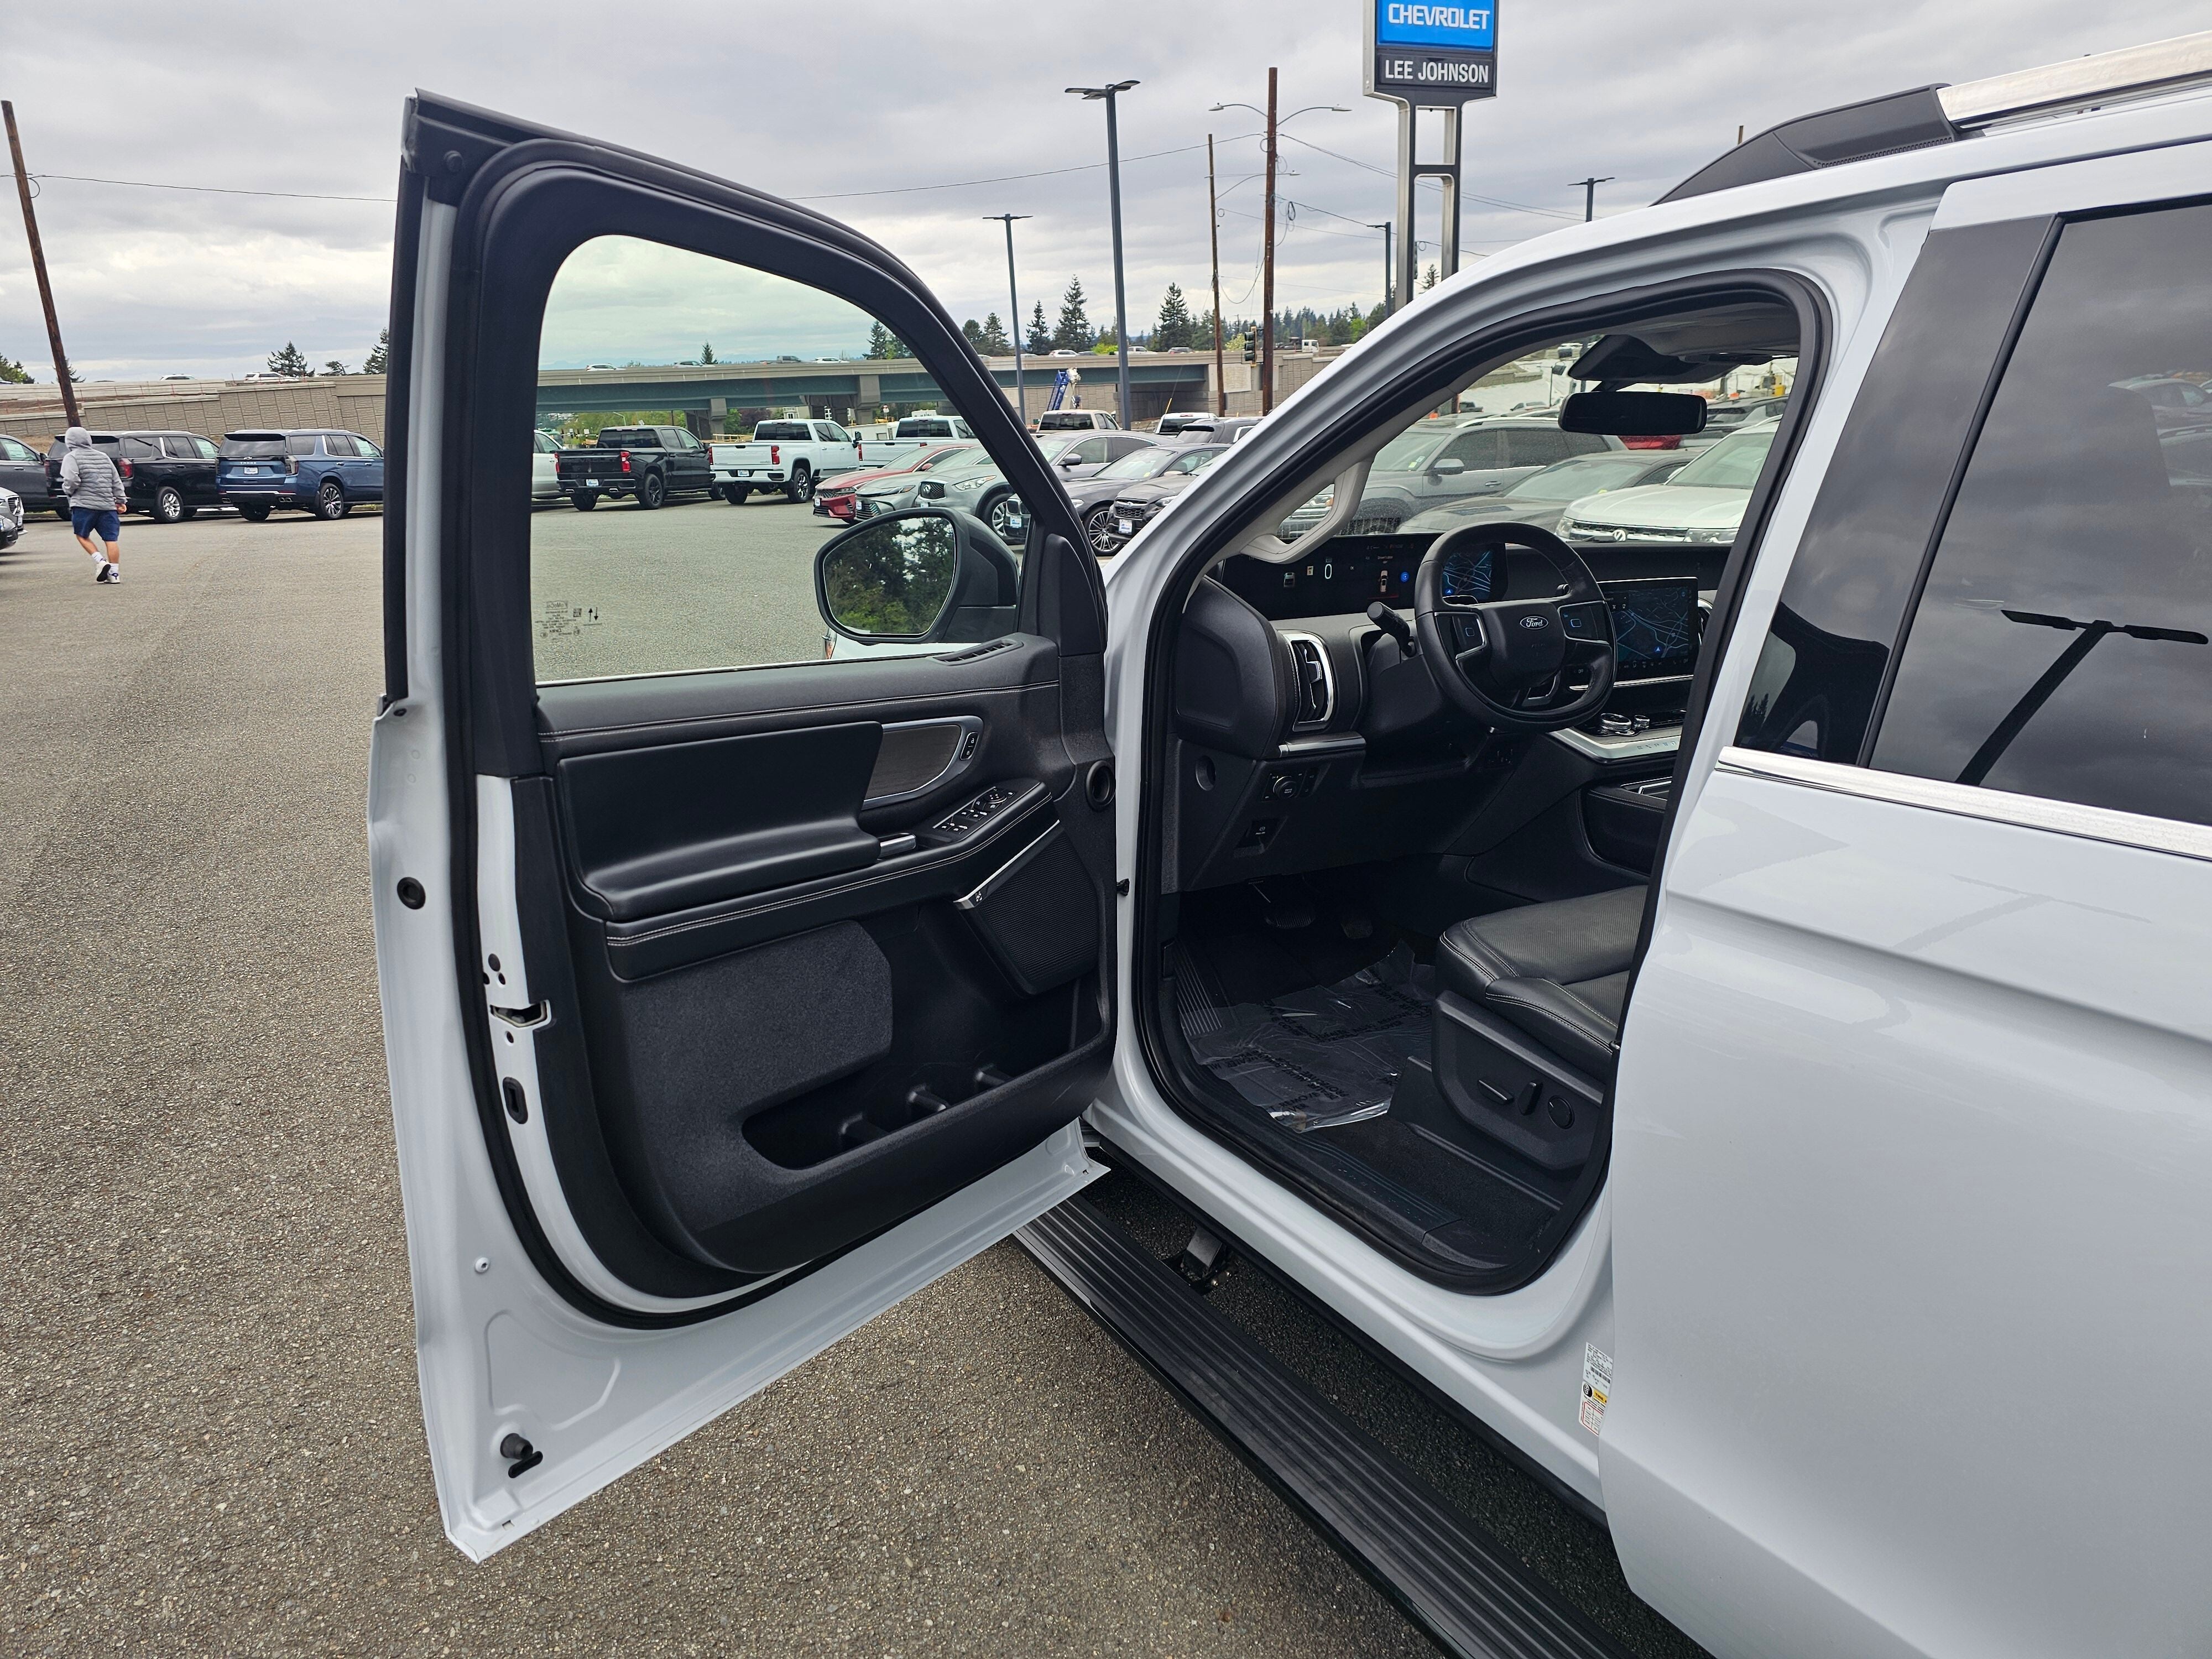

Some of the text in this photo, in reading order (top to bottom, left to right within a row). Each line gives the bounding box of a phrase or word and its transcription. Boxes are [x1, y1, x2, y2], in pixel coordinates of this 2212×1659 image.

[1389, 3, 1490, 29] CHEVROLET
[1385, 60, 1489, 83] LEE JOHNSON
[1526, 618, 1544, 628] Ford
